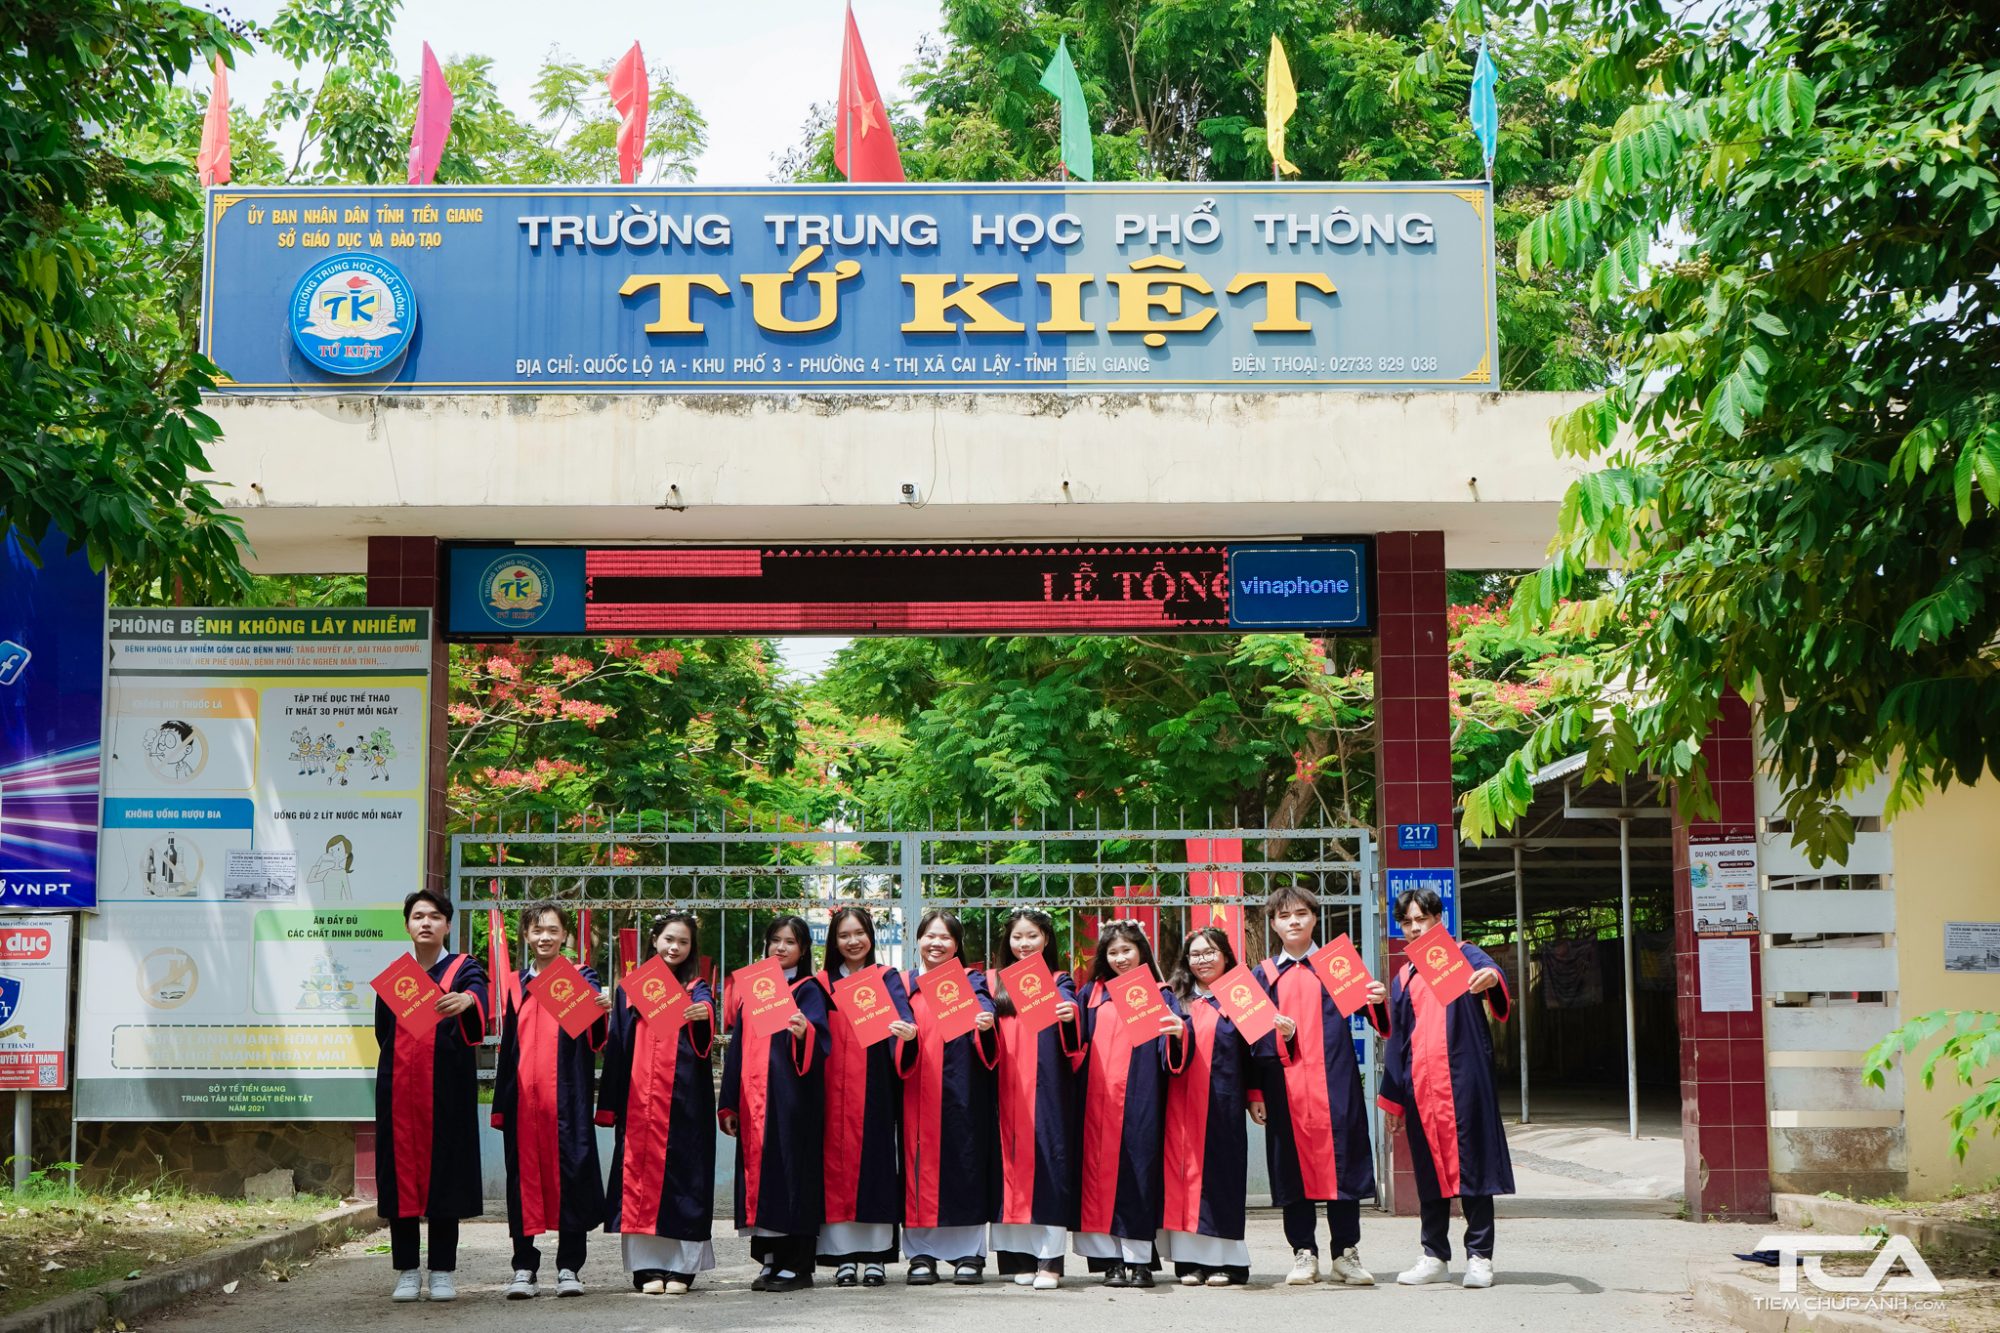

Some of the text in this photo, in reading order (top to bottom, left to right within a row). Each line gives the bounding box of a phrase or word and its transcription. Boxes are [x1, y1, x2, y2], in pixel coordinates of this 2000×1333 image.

[248, 204, 484, 224] ỦY BAN NHÂN DÂN TỈNH TIỀN GIANG
[518, 198, 1435, 252] TRƯỜNG TRUNG HỌC PHỔ THÔNG
[278, 228, 442, 250] SỞ GIÁO DỤC VÀ ĐÀO TẠO
[298, 278, 318, 318] TRƯỜNG
[316, 261, 350, 282] TRUNG
[352, 262, 374, 273] HỌC
[392, 284, 405, 318] THÔNG
[618, 244, 1338, 347] TỨ KIỆT
[324, 295, 375, 322] TK
[318, 342, 383, 359] TỨ KIỆT
[516, 358, 542, 377] ĐỊA
[583, 354, 628, 374] QUỐC
[632, 355, 653, 378] LỘ
[659, 358, 676, 374] 1A
[692, 358, 725, 373] KHU
[734, 352, 767, 373] PHỐ
[772, 358, 781, 372] 3
[800, 354, 865, 373] PHƯỜNG
[871, 358, 880, 372] 4
[894, 357, 918, 376] THỊ
[924, 354, 946, 372] XÃ
[952, 357, 976, 372] CAI
[983, 353, 1010, 376] LẬY
[1024, 352, 1057, 373] TỈNH
[1063, 352, 1096, 373] TIỀN
[1102, 357, 1150, 372] GIANG
[1232, 352, 1264, 376] ĐIỆN
[1330, 356, 1373, 372] 02733
[1379, 356, 1405, 372] 829
[1411, 356, 1438, 372] 038
[500, 579, 530, 598] TK
[1041, 562, 1099, 601] LỄ
[1240, 576, 1349, 598] vinaphone
[110, 614, 416, 636] PHÒNG BỆNH KHÔNG LÂY NHIỄM
[294, 691, 390, 704] TẬP THỂ DỤC THỂ THAO
[286, 706, 293, 715] ÍT
[296, 705, 317, 716] NHẤT
[320, 707, 330, 715] 30
[333, 706, 354, 715] PHÚT
[376, 705, 398, 715] NGÀY
[125, 808, 222, 820] KHÔNG UỐNG RƯỢU BIA
[274, 808, 296, 820] UỐNG
[314, 812, 319, 820] 2
[321, 810, 334, 820] LÍT
[336, 810, 359, 820] NƯỚC
[380, 810, 403, 820] NGÀY
[1405, 826, 1430, 840] 217
[11, 884, 72, 896] VNPT
[1443, 879, 1452, 898] XE
[314, 916, 324, 924] ĂN
[288, 928, 304, 938] CÁC
[307, 926, 329, 938] CHẤT
[332, 930, 352, 938] DINH
[6, 932, 48, 956] dục
[229, 1083, 240, 1092] TẾ
[240, 1082, 260, 1092] TIỀN
[211, 1094, 228, 1102] TÂM
[230, 1092, 249, 1102] KIỂM
[250, 1094, 272, 1102] SOÁT
[274, 1094, 296, 1104] BỆNH
[228, 1104, 246, 1112] NĂM
